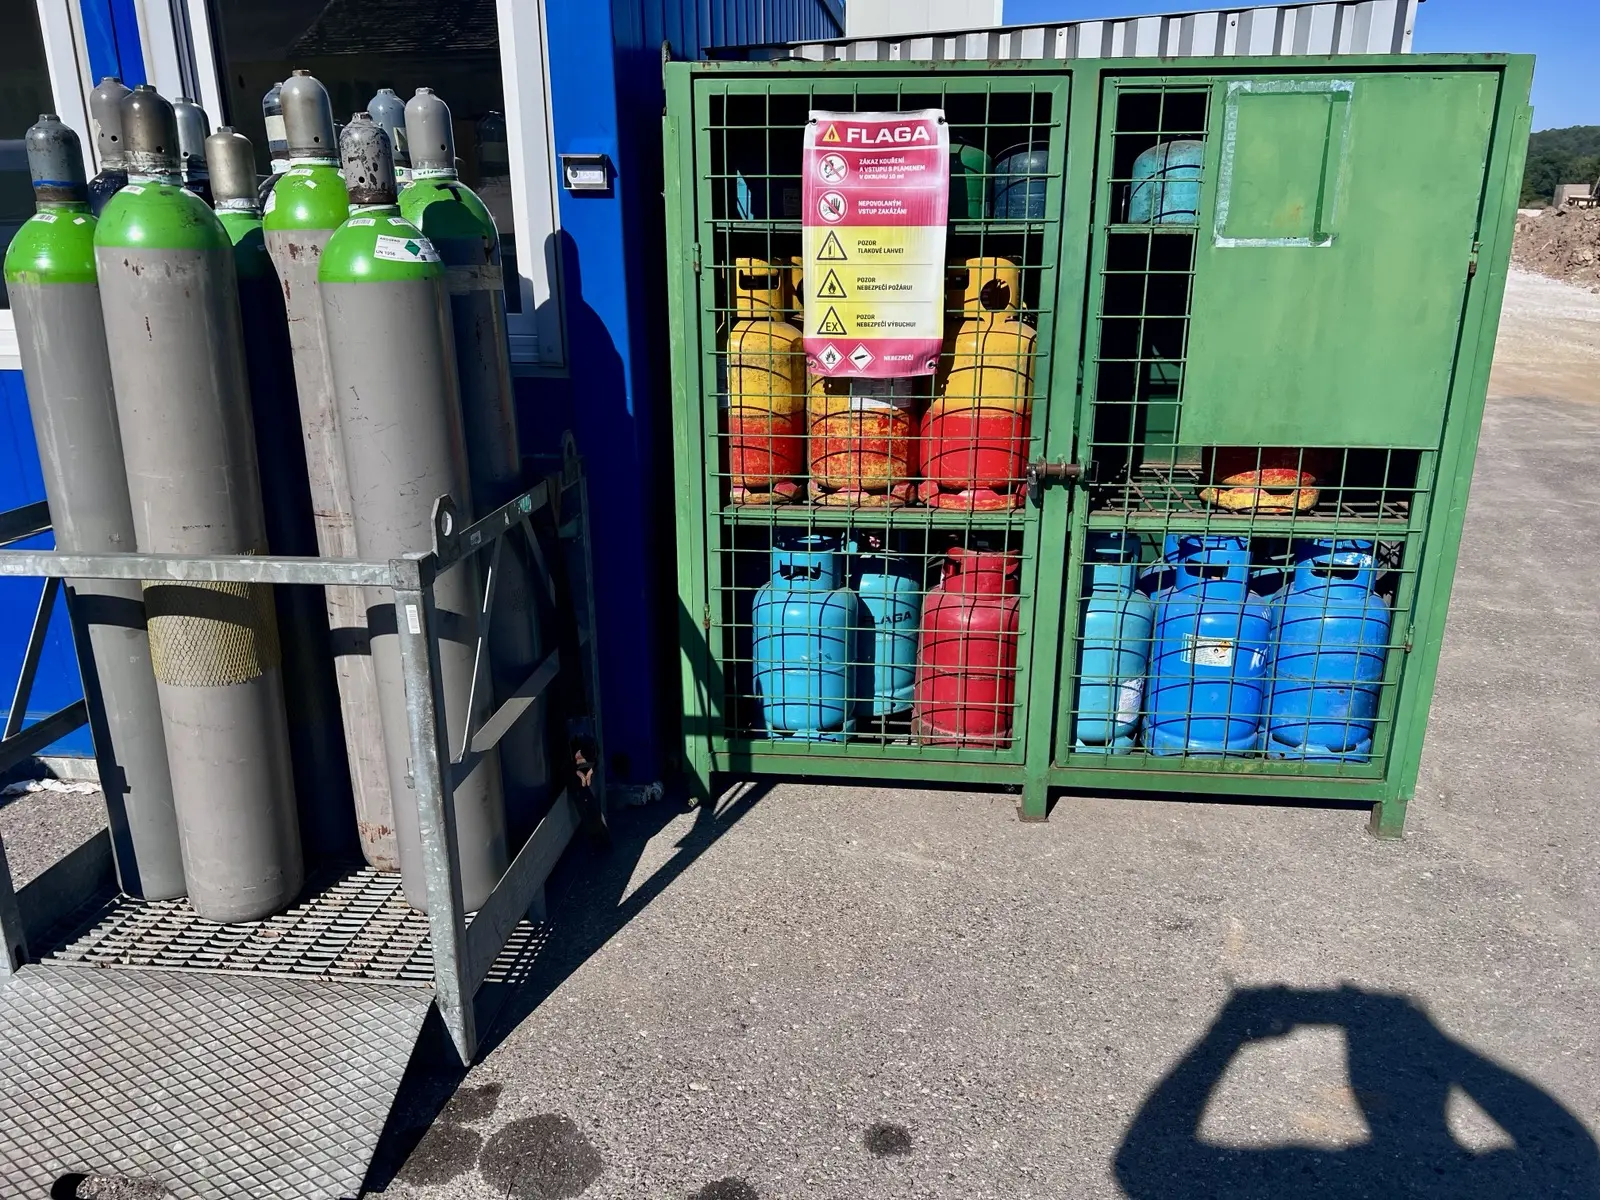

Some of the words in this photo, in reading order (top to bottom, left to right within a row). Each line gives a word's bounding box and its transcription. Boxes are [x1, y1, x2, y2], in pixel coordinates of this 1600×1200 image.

[847, 125, 930, 144] FLAGA
[879, 156, 905, 165] KOUŘENÍ
[893, 164, 925, 172] PLAMENEM
[858, 199, 902, 207] NEPOVOLANÝM
[857, 246, 882, 254] TLAKOVÉ
[857, 283, 887, 291] NEBEZPEČÍ
[825, 321, 838, 332] EX
